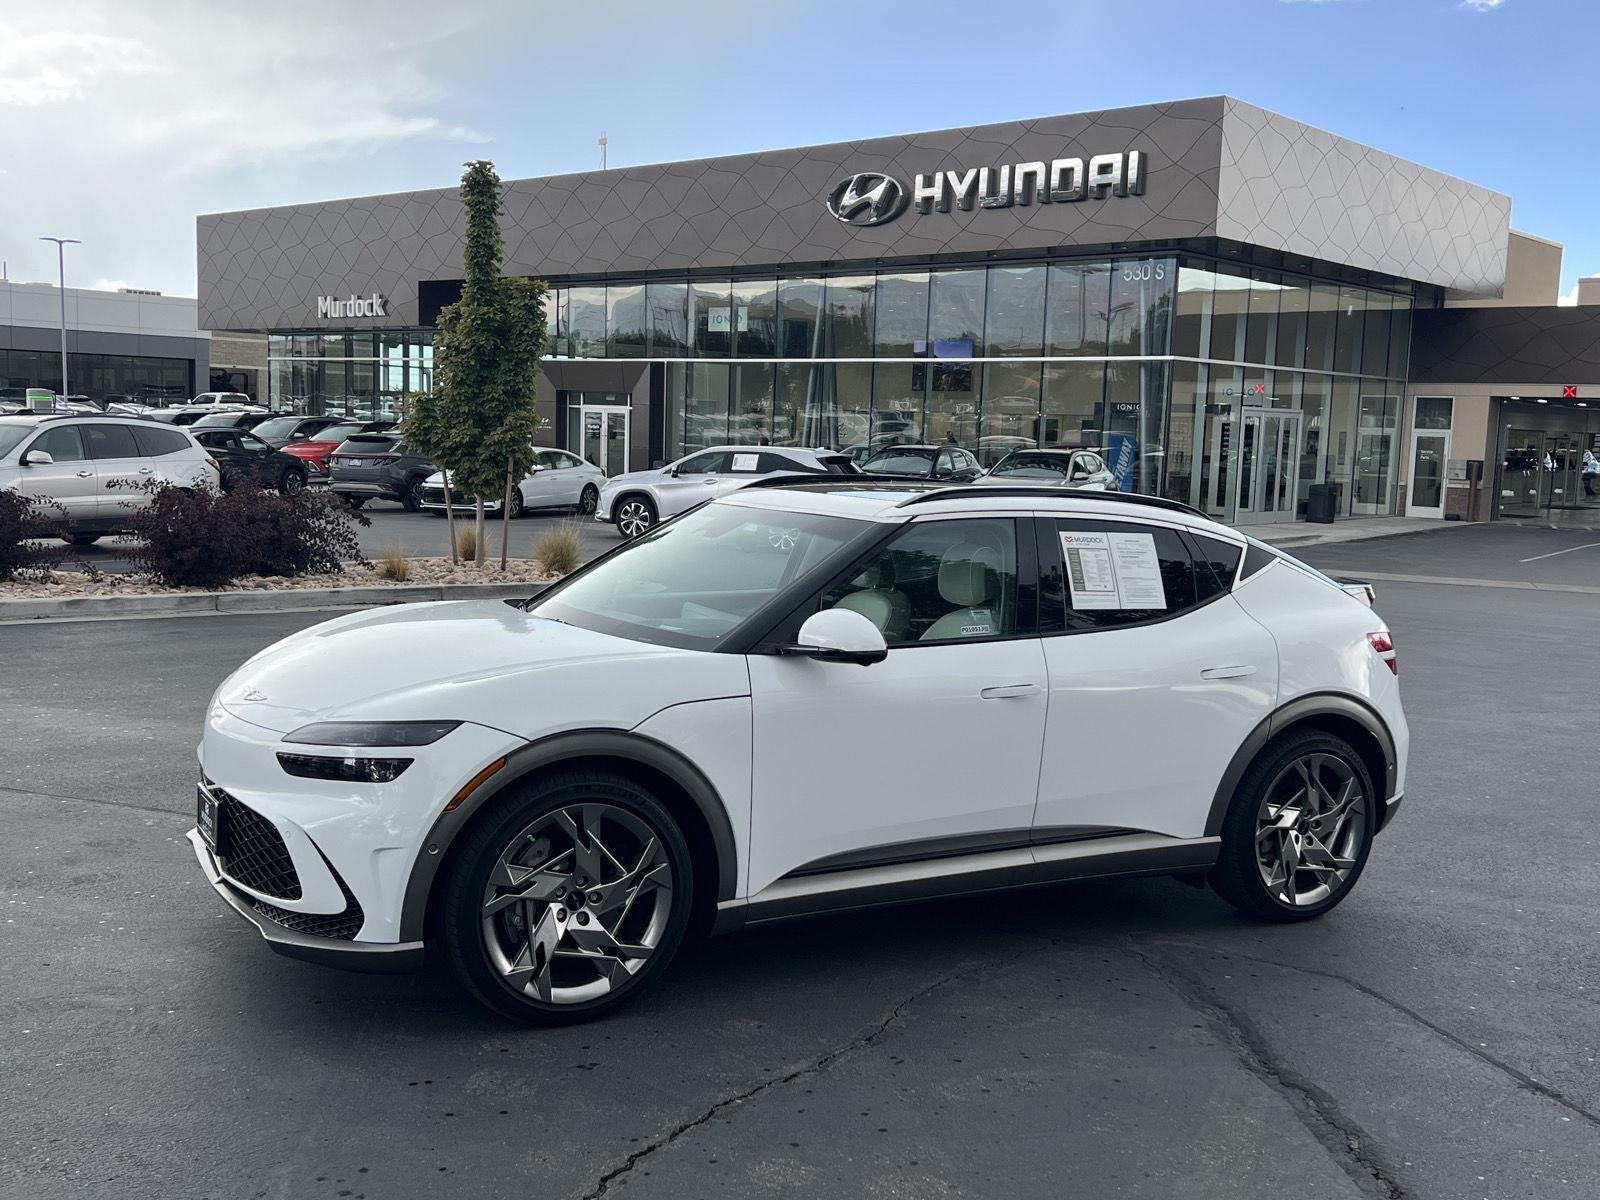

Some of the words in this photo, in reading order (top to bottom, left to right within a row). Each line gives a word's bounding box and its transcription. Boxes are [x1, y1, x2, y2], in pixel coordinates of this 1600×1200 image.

[914, 150, 1145, 214] HYUNDAI
[1123, 264, 1151, 281] 530
[1155, 264, 1165, 280] S
[317, 293, 386, 319] Murdock
[1112, 436, 1133, 492] ETAWAY
